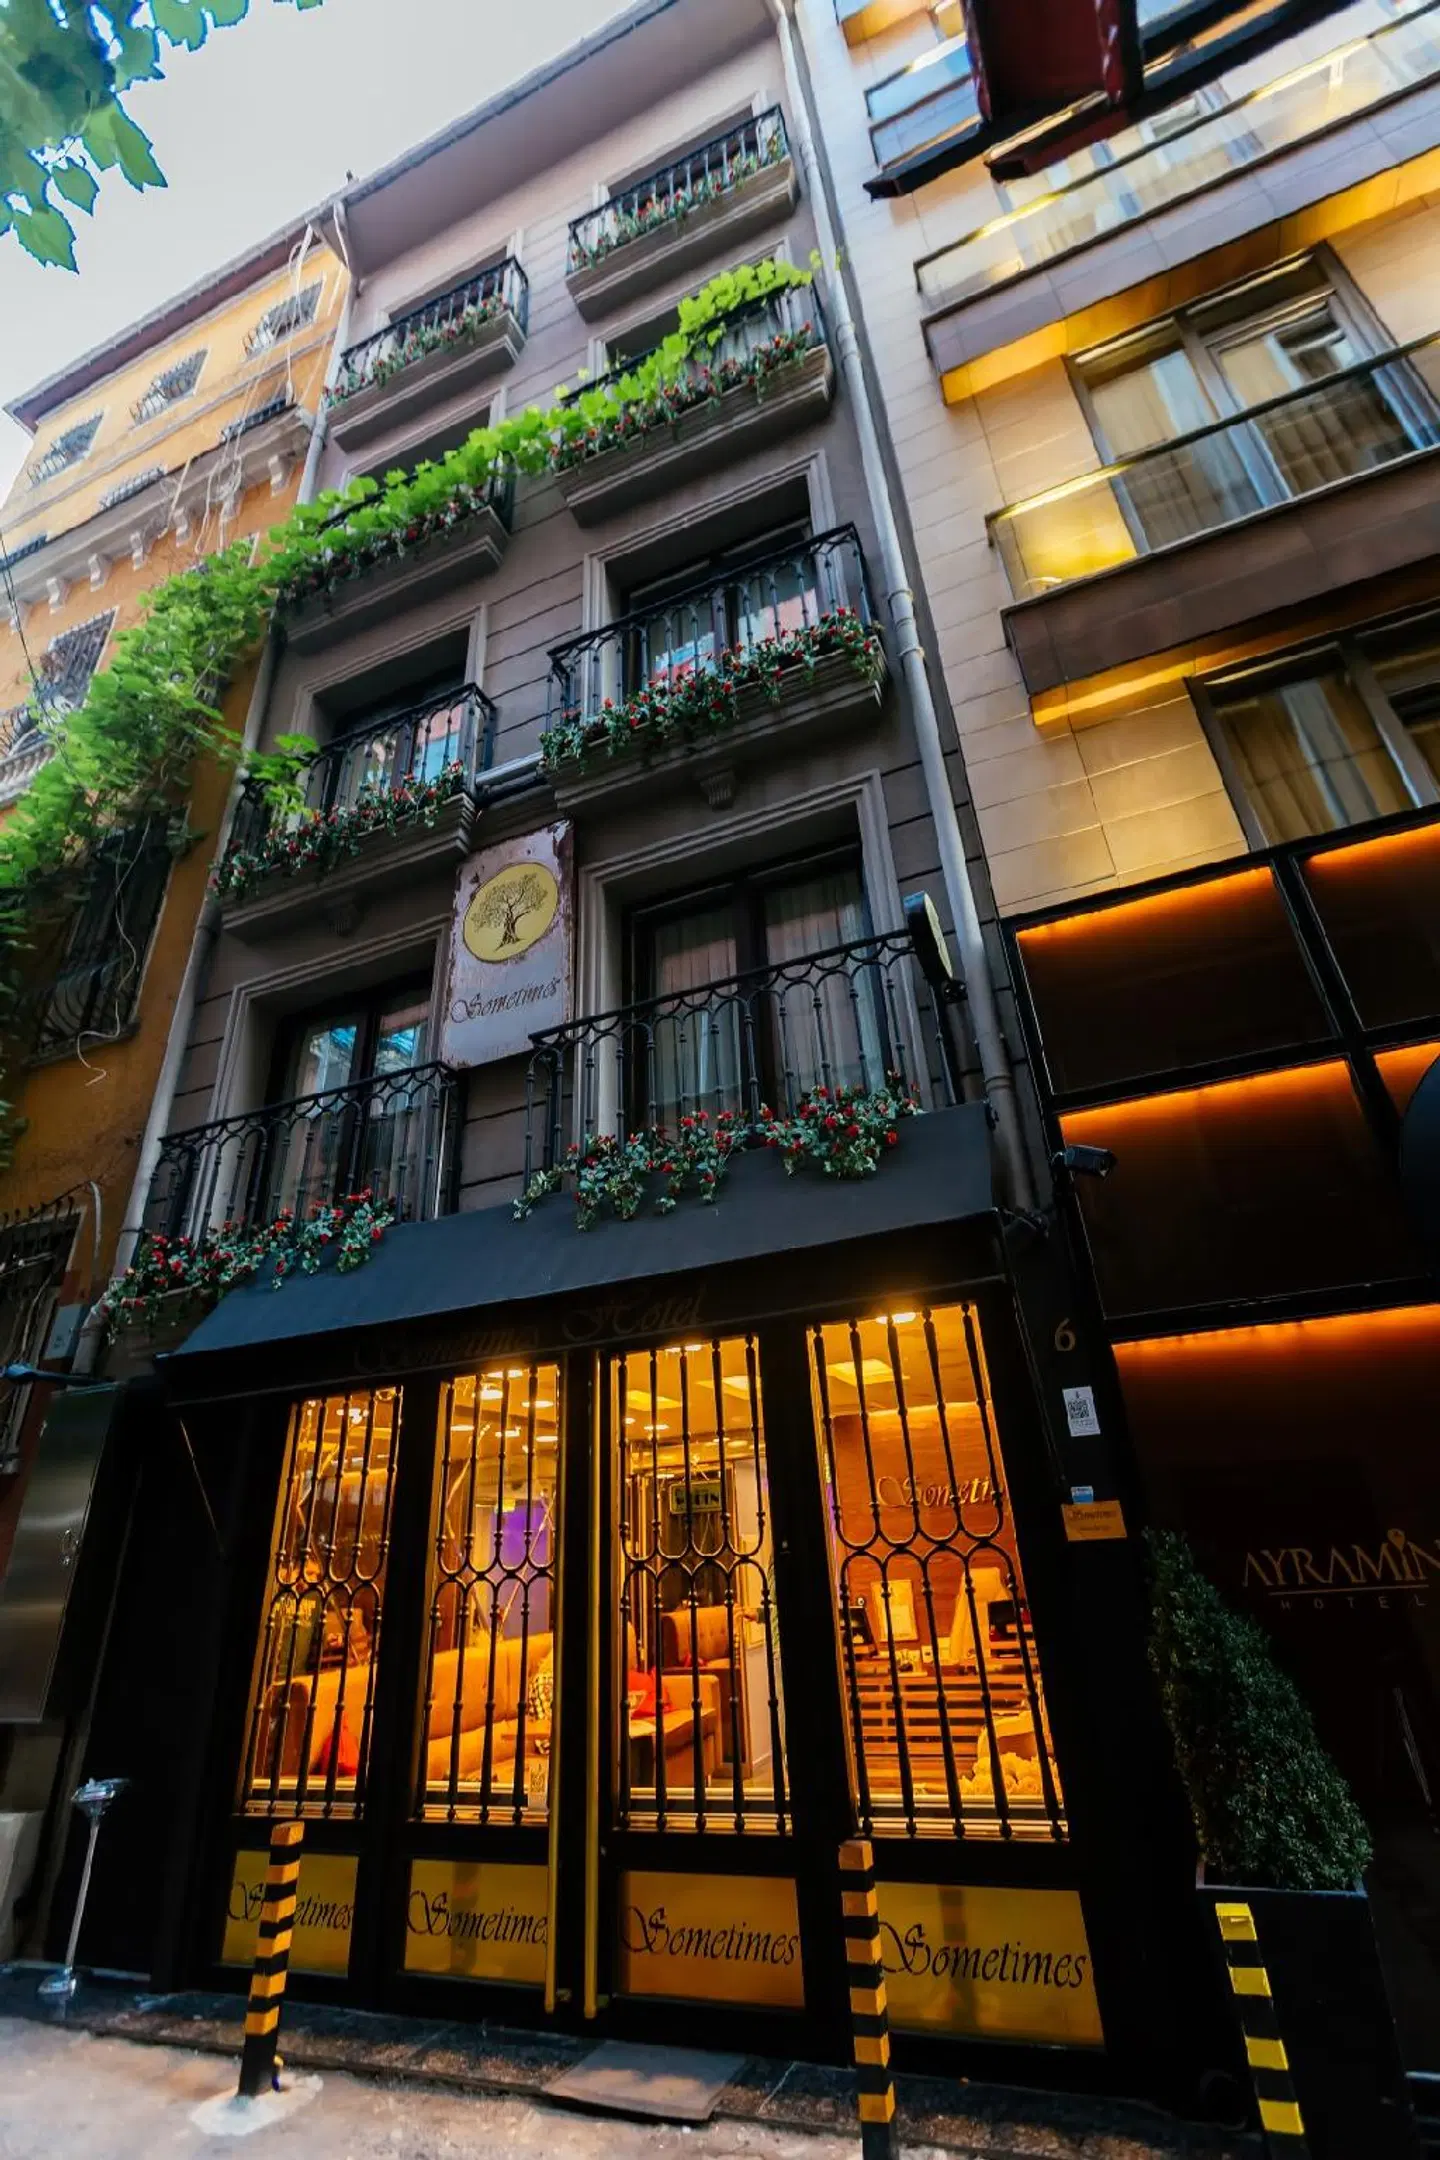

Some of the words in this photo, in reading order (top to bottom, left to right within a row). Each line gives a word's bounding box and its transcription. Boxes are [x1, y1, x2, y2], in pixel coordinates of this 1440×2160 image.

[450, 976, 561, 1024] Sometimes
[1054, 1317, 1076, 1351] 6
[1279, 1594, 1426, 1610] HOTEL
[407, 1889, 547, 1944] Sometime
[621, 1906, 799, 1966] Sometimes
[879, 1921, 1087, 1989] Sometimes
